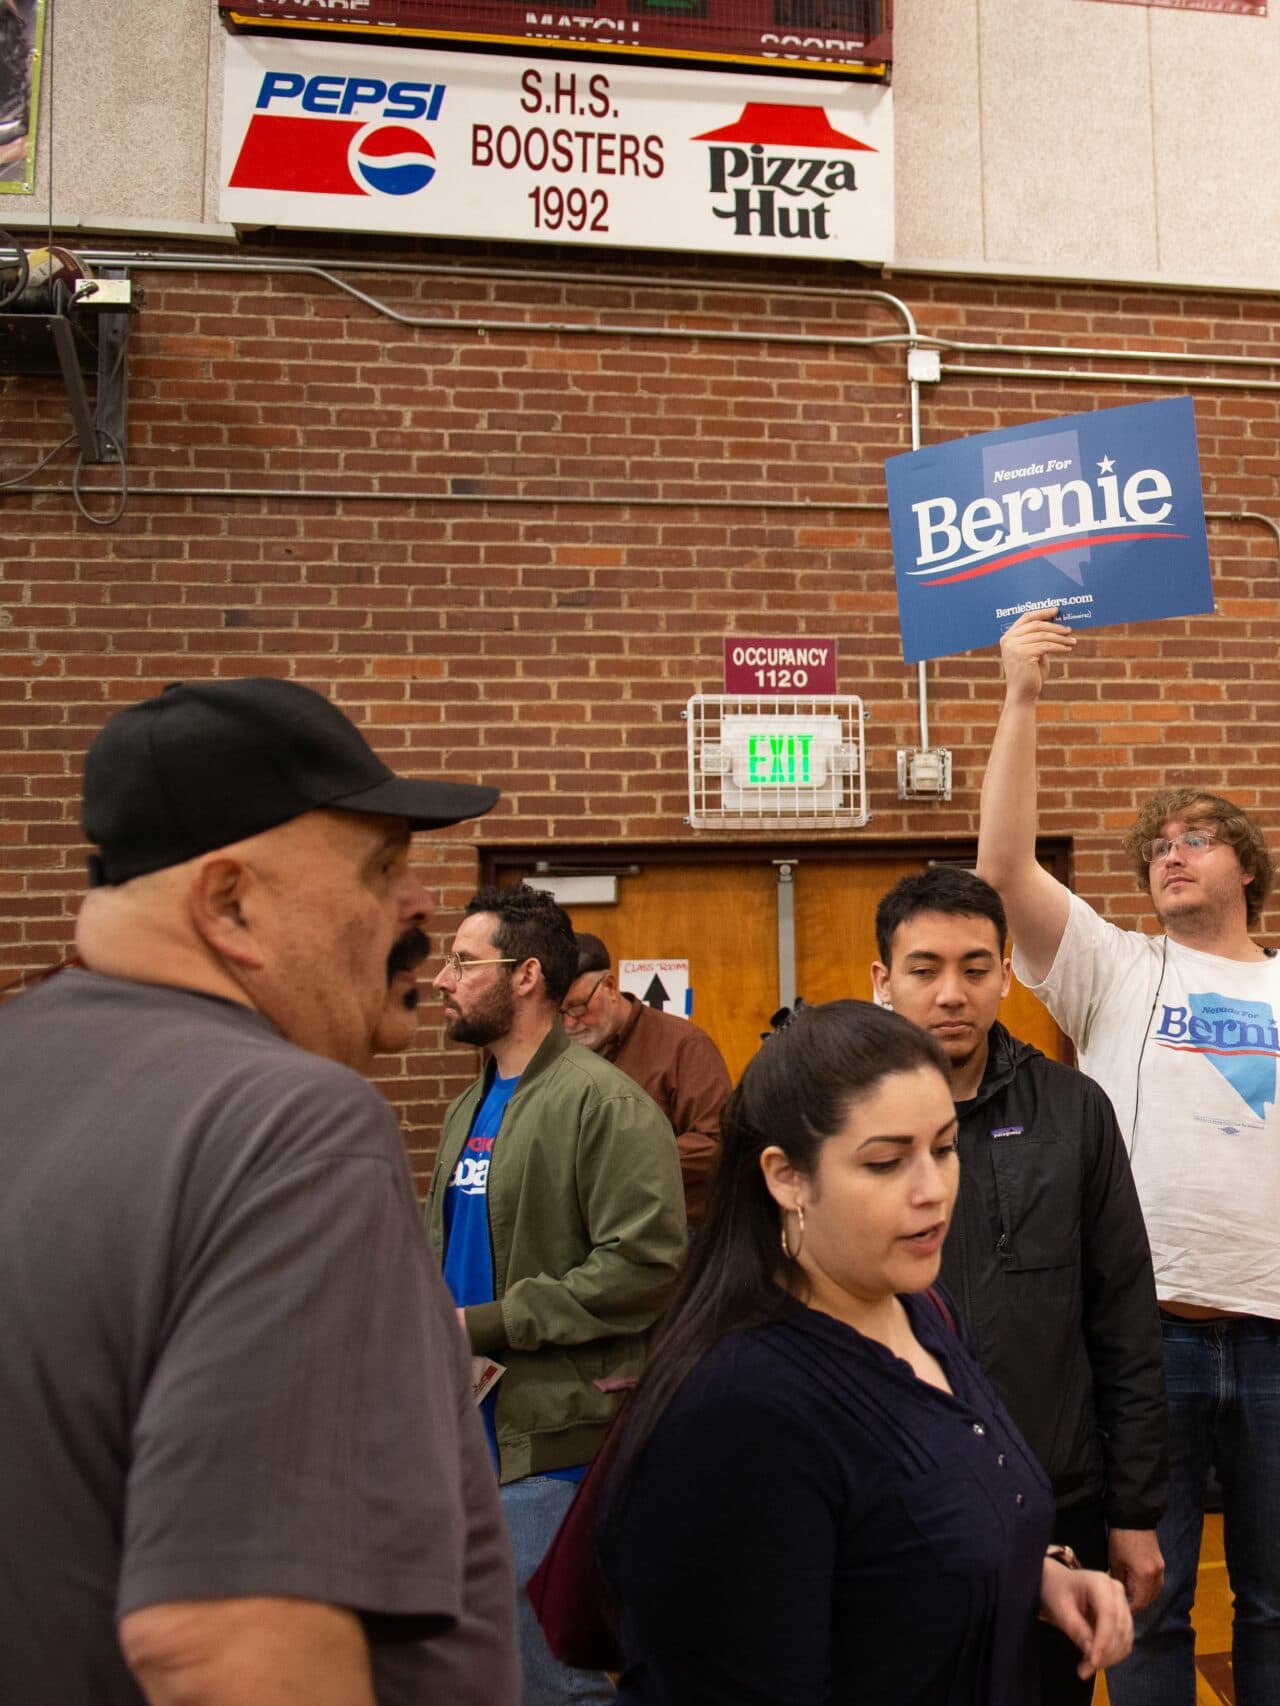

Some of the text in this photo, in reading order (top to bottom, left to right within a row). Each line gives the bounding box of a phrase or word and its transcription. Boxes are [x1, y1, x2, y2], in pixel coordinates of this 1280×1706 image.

[255, 71, 446, 121] PEPSI
[520, 69, 619, 118] S.H.S.
[472, 123, 664, 179] BOOSTERS
[708, 143, 858, 198] Pizza
[528, 186, 609, 232] 1992
[712, 185, 831, 239] Hut
[993, 458, 1072, 484] Nevada For
[911, 455, 1173, 566] Bernie
[996, 593, 1094, 619] BernieSanders.com
[732, 646, 828, 667] OCCUPANCY
[754, 669, 809, 688] 1120
[748, 735, 814, 784] EXIT
